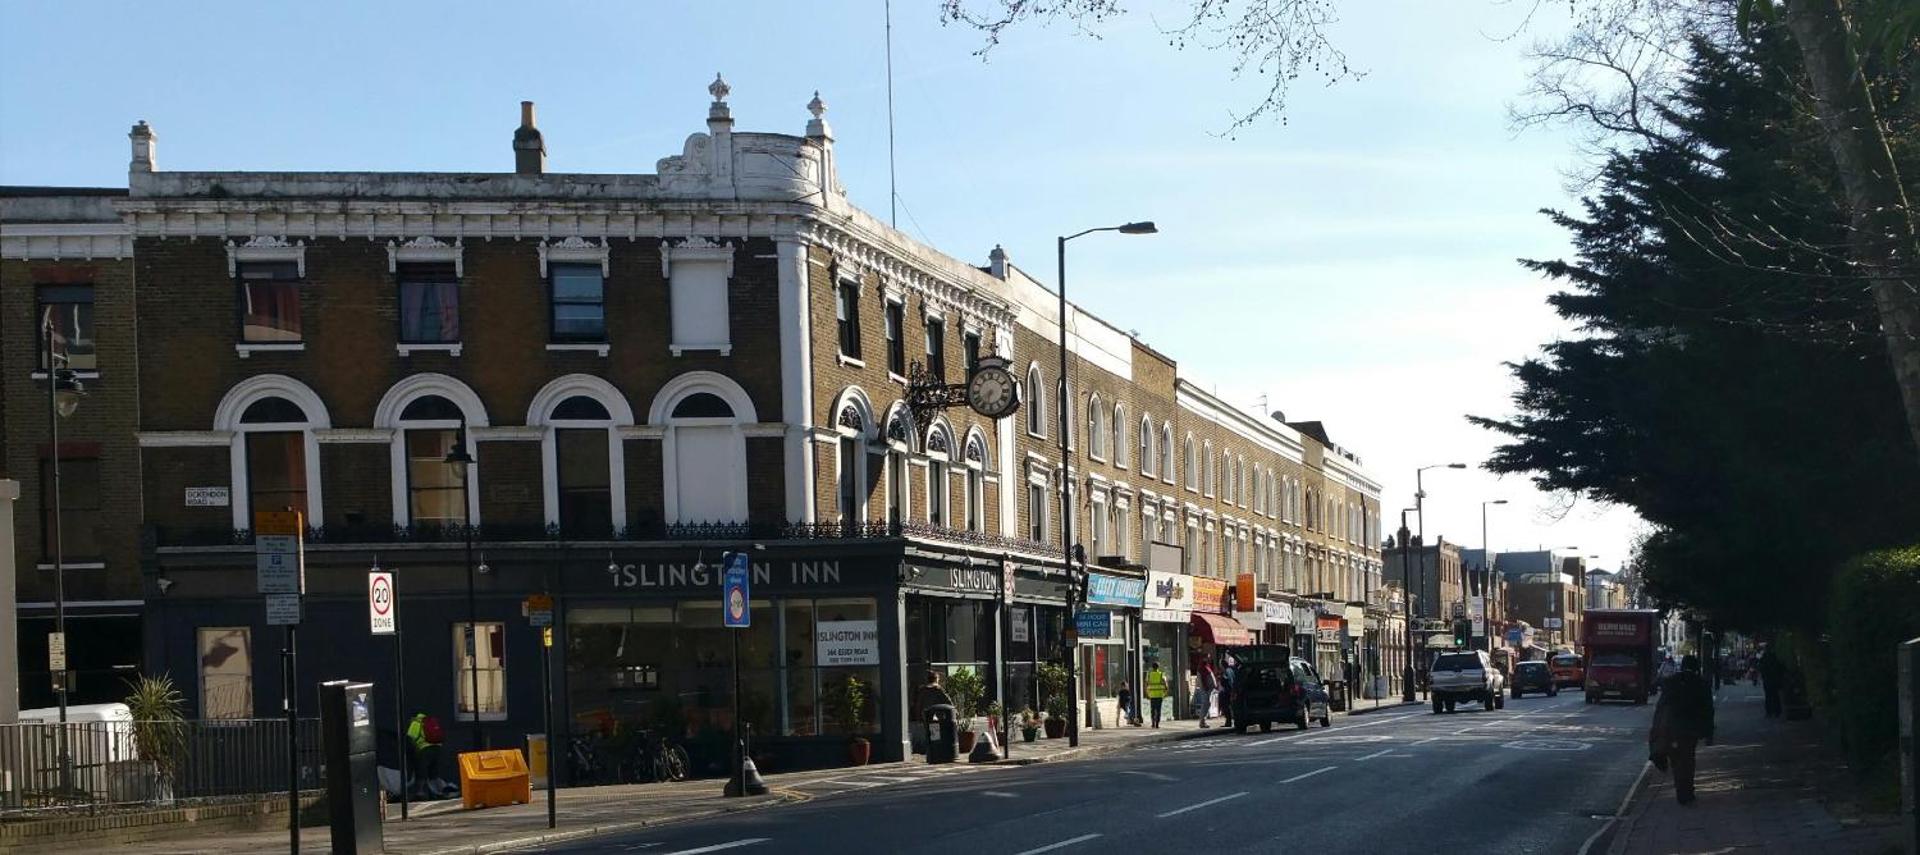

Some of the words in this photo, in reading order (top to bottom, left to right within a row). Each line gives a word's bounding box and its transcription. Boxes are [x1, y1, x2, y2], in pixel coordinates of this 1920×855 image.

[613, 562, 770, 587] ISLINGTN
[792, 560, 840, 584] INN
[950, 567, 997, 590] ISLINGTON
[375, 588, 389, 604] 20
[373, 617, 392, 628] ZONE
[817, 631, 861, 641] ISLINGTON
